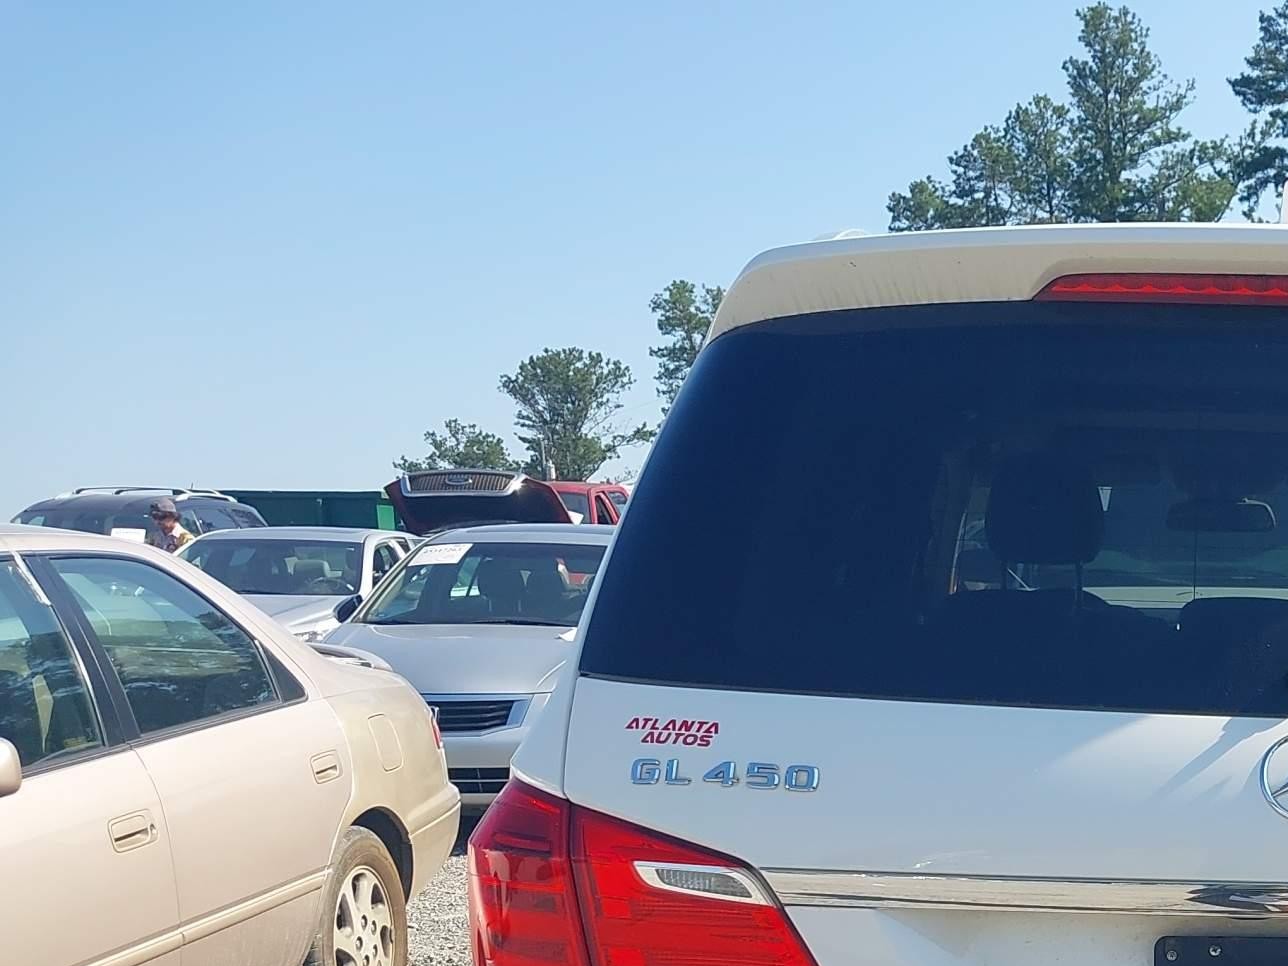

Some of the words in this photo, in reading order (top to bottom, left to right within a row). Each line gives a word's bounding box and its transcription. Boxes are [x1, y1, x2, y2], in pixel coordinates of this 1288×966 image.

[625, 717, 719, 734] ATLANTA
[640, 731, 713, 748] AUTOS
[630, 757, 692, 786] GL
[702, 760, 820, 792] 450
